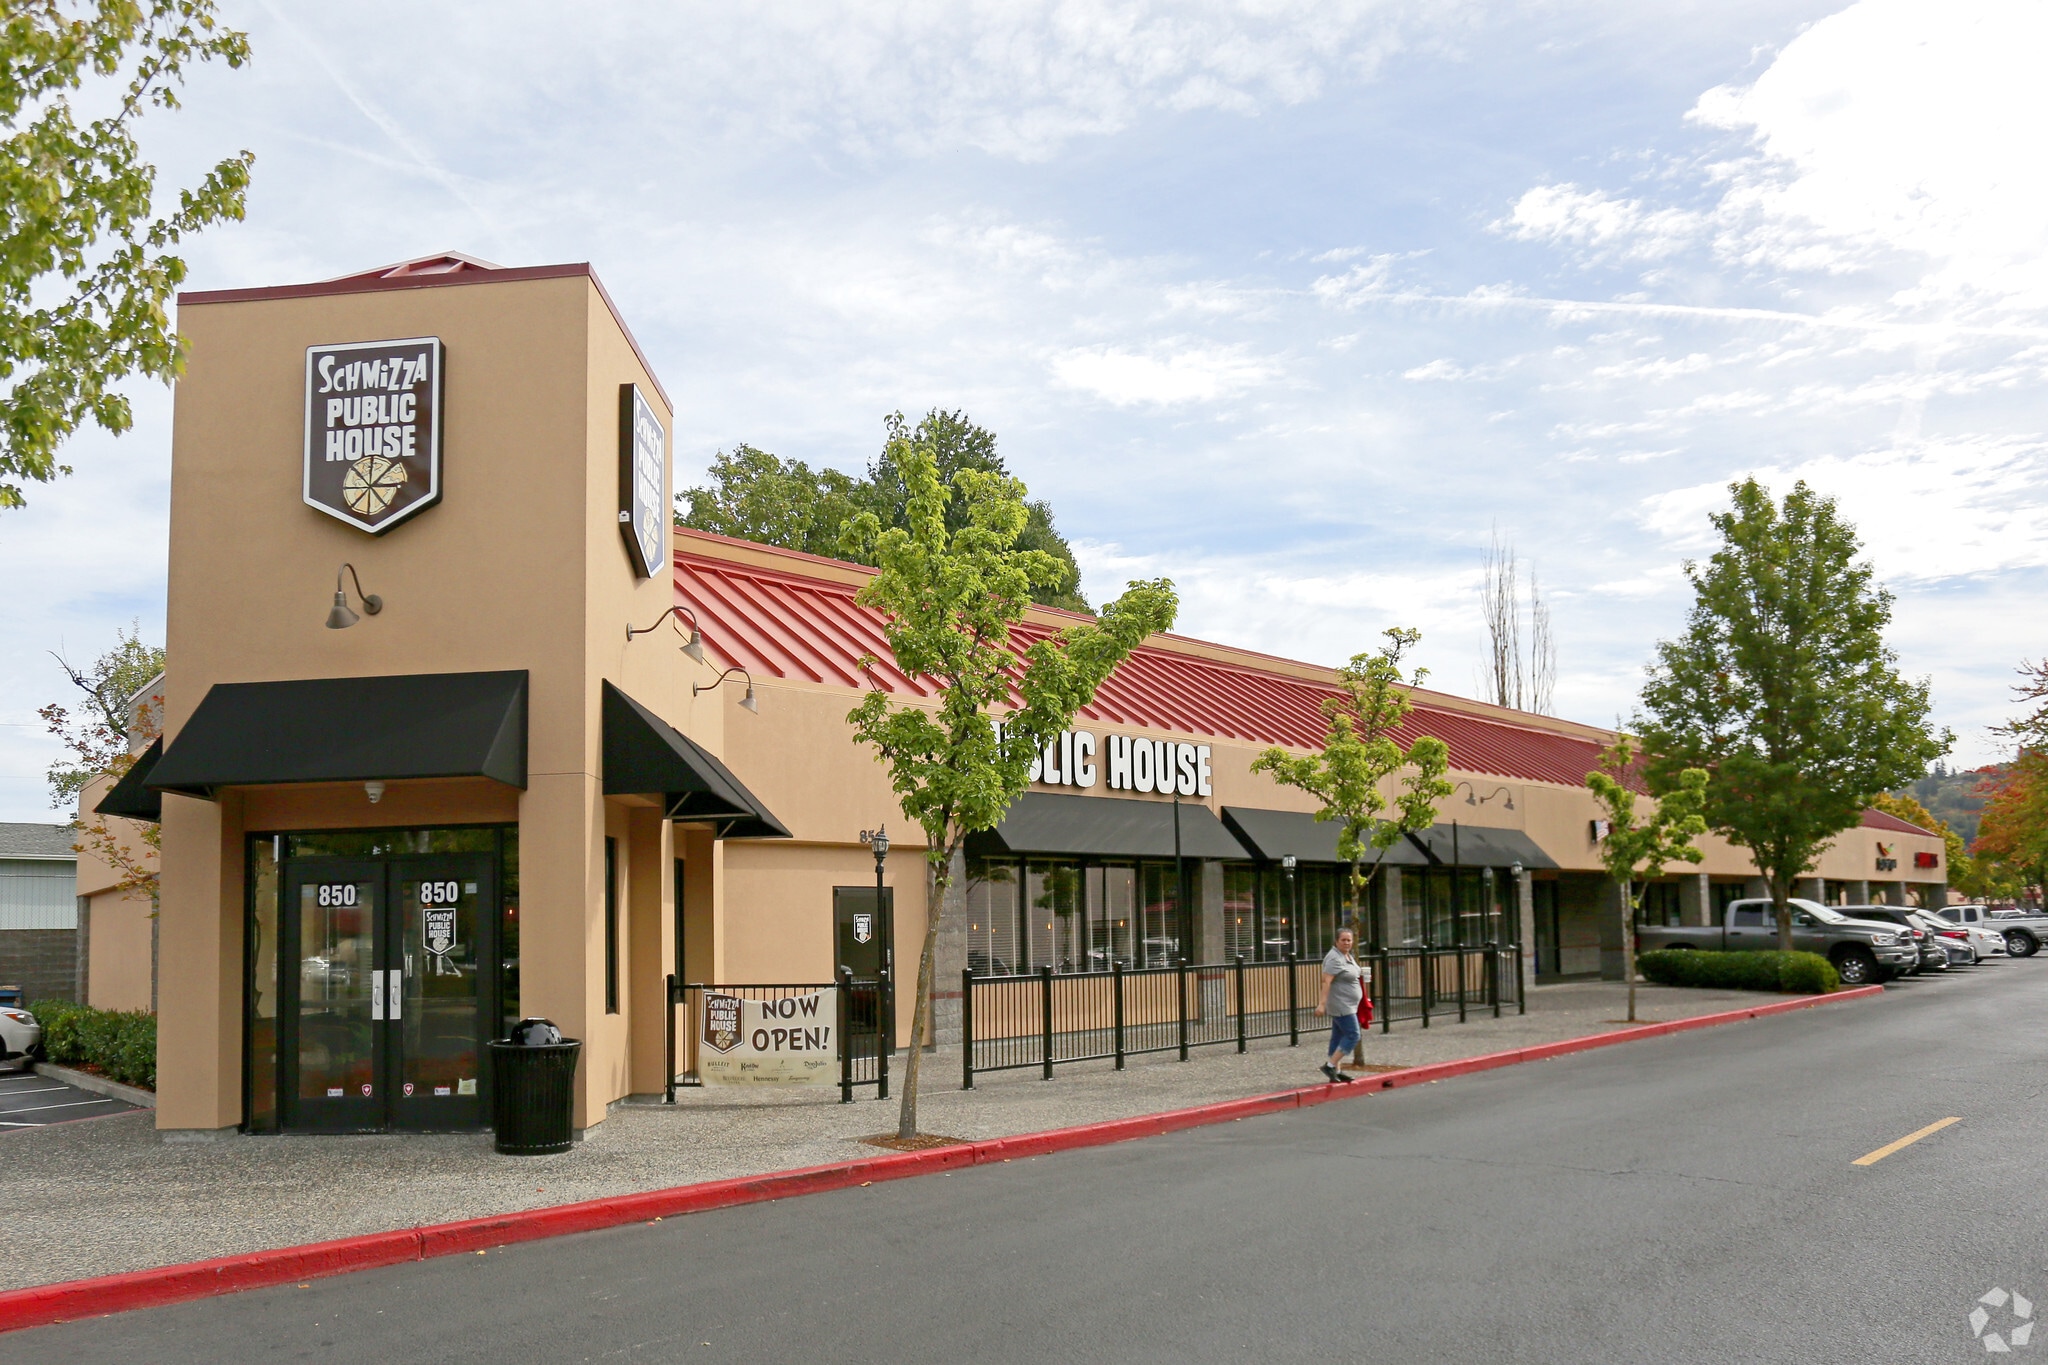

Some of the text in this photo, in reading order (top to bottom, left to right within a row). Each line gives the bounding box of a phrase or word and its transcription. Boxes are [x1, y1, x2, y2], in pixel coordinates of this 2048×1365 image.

[326, 393, 416, 428] PUBLIC
[325, 425, 416, 462] HOUSE
[638, 440, 660, 493] PUBLIC
[1108, 734, 1213, 797] HOUSE
[318, 885, 356, 906] 850
[420, 881, 458, 903] 850
[428, 922, 451, 930] PUBLIC
[428, 930, 451, 939] HOUSE
[710, 1010, 737, 1020] PUBLIC
[761, 995, 820, 1020] NOW
[710, 1020, 737, 1032] HOUSE
[751, 1026, 830, 1052] OPEN!
